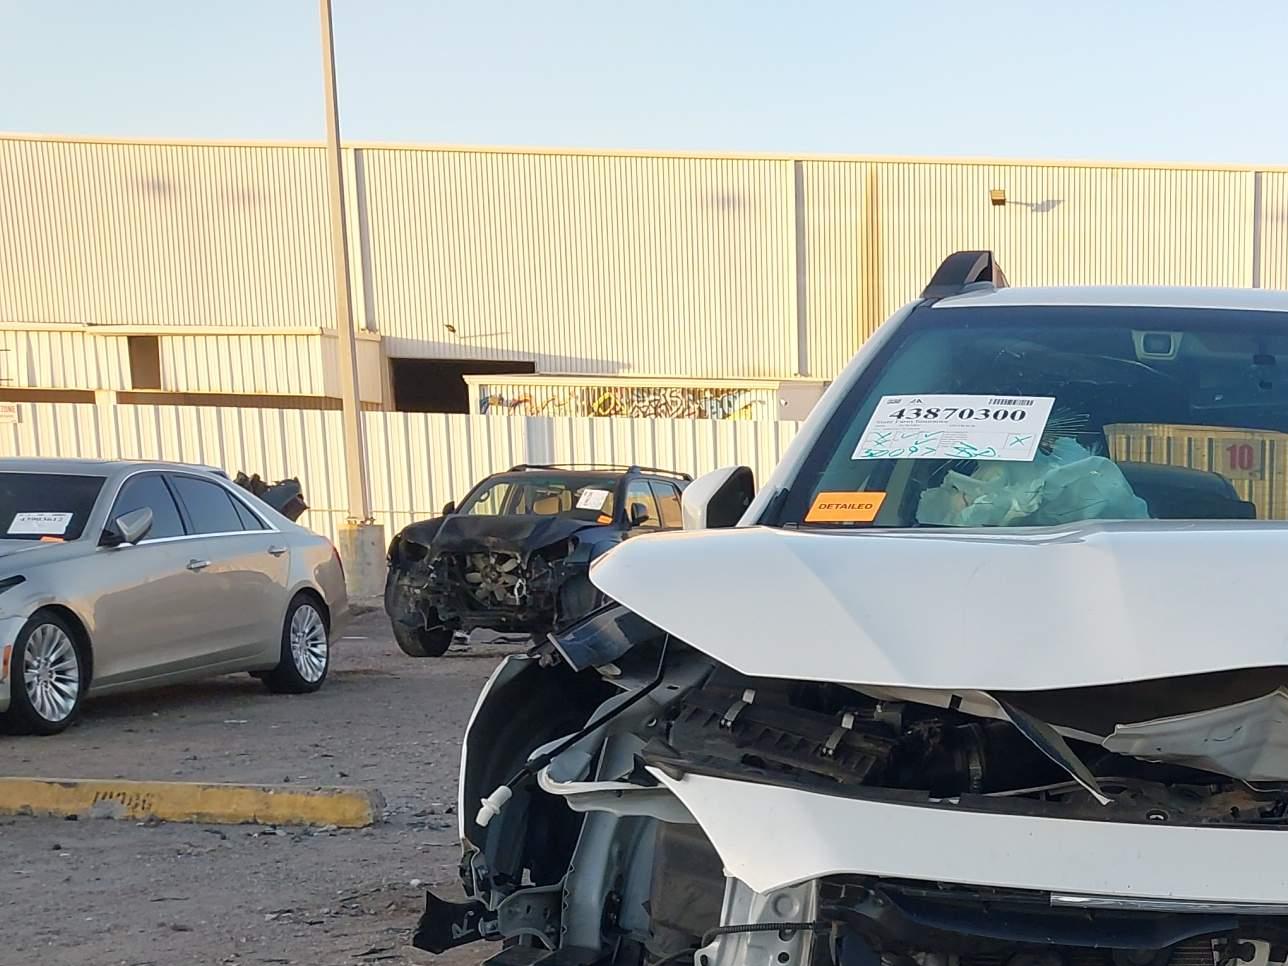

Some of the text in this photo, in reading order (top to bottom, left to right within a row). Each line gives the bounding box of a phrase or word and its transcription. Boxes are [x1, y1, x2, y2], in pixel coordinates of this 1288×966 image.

[889, 407, 1027, 421] 43870300
[1225, 444, 1254, 470] 10
[818, 502, 873, 511] DETAILED
